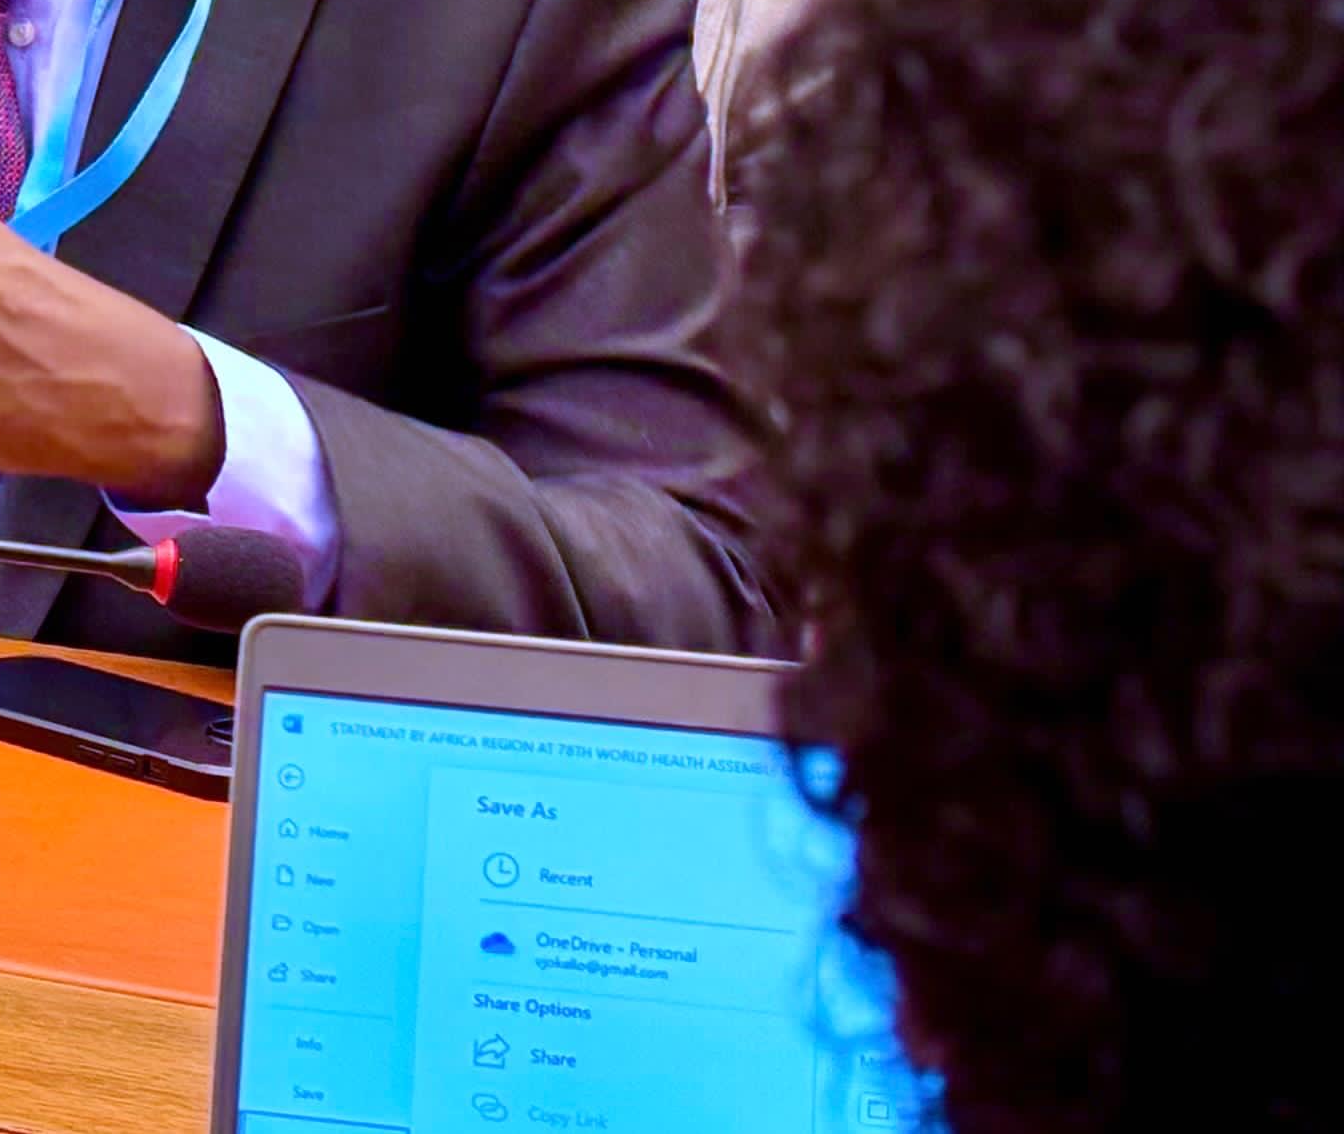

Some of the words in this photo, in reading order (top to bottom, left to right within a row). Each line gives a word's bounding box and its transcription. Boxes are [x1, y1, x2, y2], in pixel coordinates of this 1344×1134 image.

[329, 721, 406, 740] STATEMENT
[410, 729, 426, 743] BY
[429, 732, 478, 748] AFRICA
[481, 737, 535, 754] REGION
[538, 742, 553, 755] AT
[596, 747, 648, 764] WORLD
[651, 753, 704, 771] HEALTH
[476, 795, 525, 818] Save
[530, 801, 558, 821] As
[539, 867, 594, 888] Recent
[534, 931, 612, 955] OneDrive
[629, 941, 698, 964] Personal
[473, 992, 521, 1013] Share
[525, 998, 592, 1021] Options
[529, 1047, 577, 1069] Share
[527, 1104, 570, 1129] Copy
[575, 1111, 609, 1130] Link
